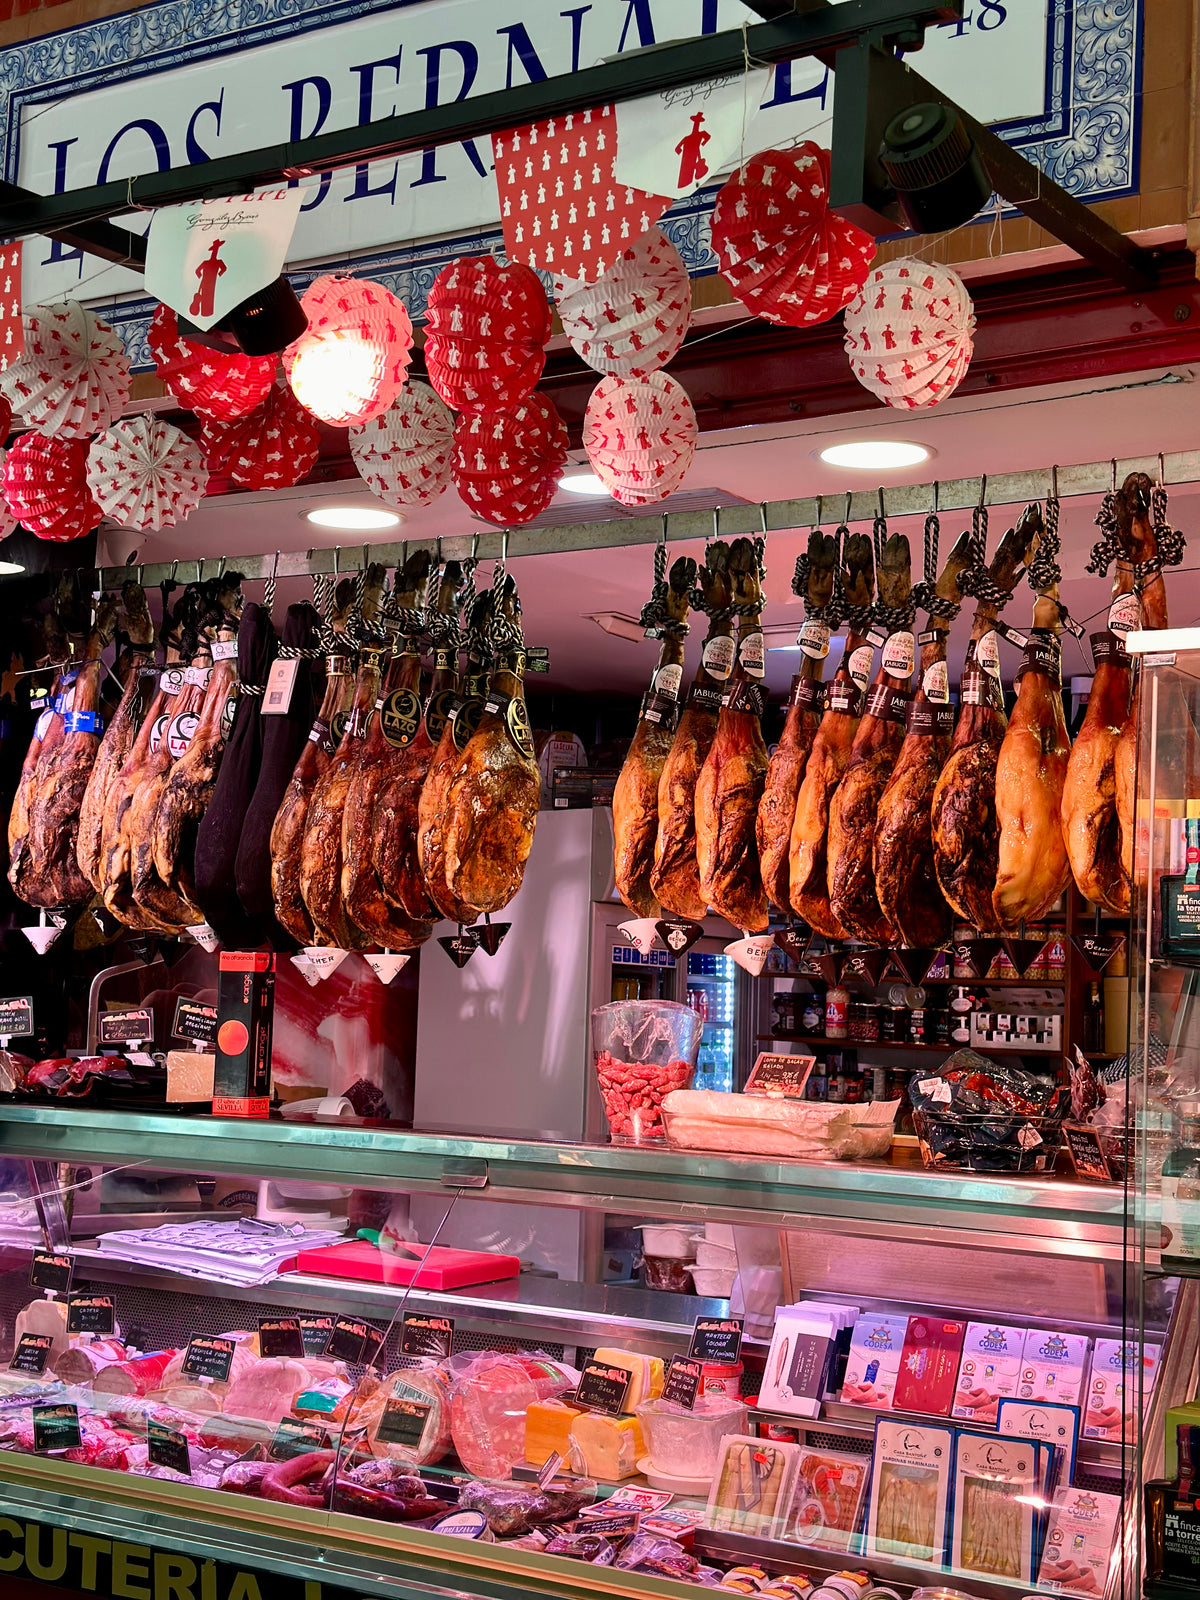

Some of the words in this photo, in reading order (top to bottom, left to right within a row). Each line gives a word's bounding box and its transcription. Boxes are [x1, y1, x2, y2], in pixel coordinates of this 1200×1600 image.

[937, 712, 954, 721] JABUG
[384, 714, 416, 733] LAZO
[864, 1340, 894, 1350] CODESA
[978, 1340, 1008, 1350] CODESA
[1038, 1347, 1069, 1358] CODESA
[1068, 1506, 1100, 1519] CODESA
[1165, 1528, 1174, 1536] la
[1176, 1530, 1200, 1541] torre
